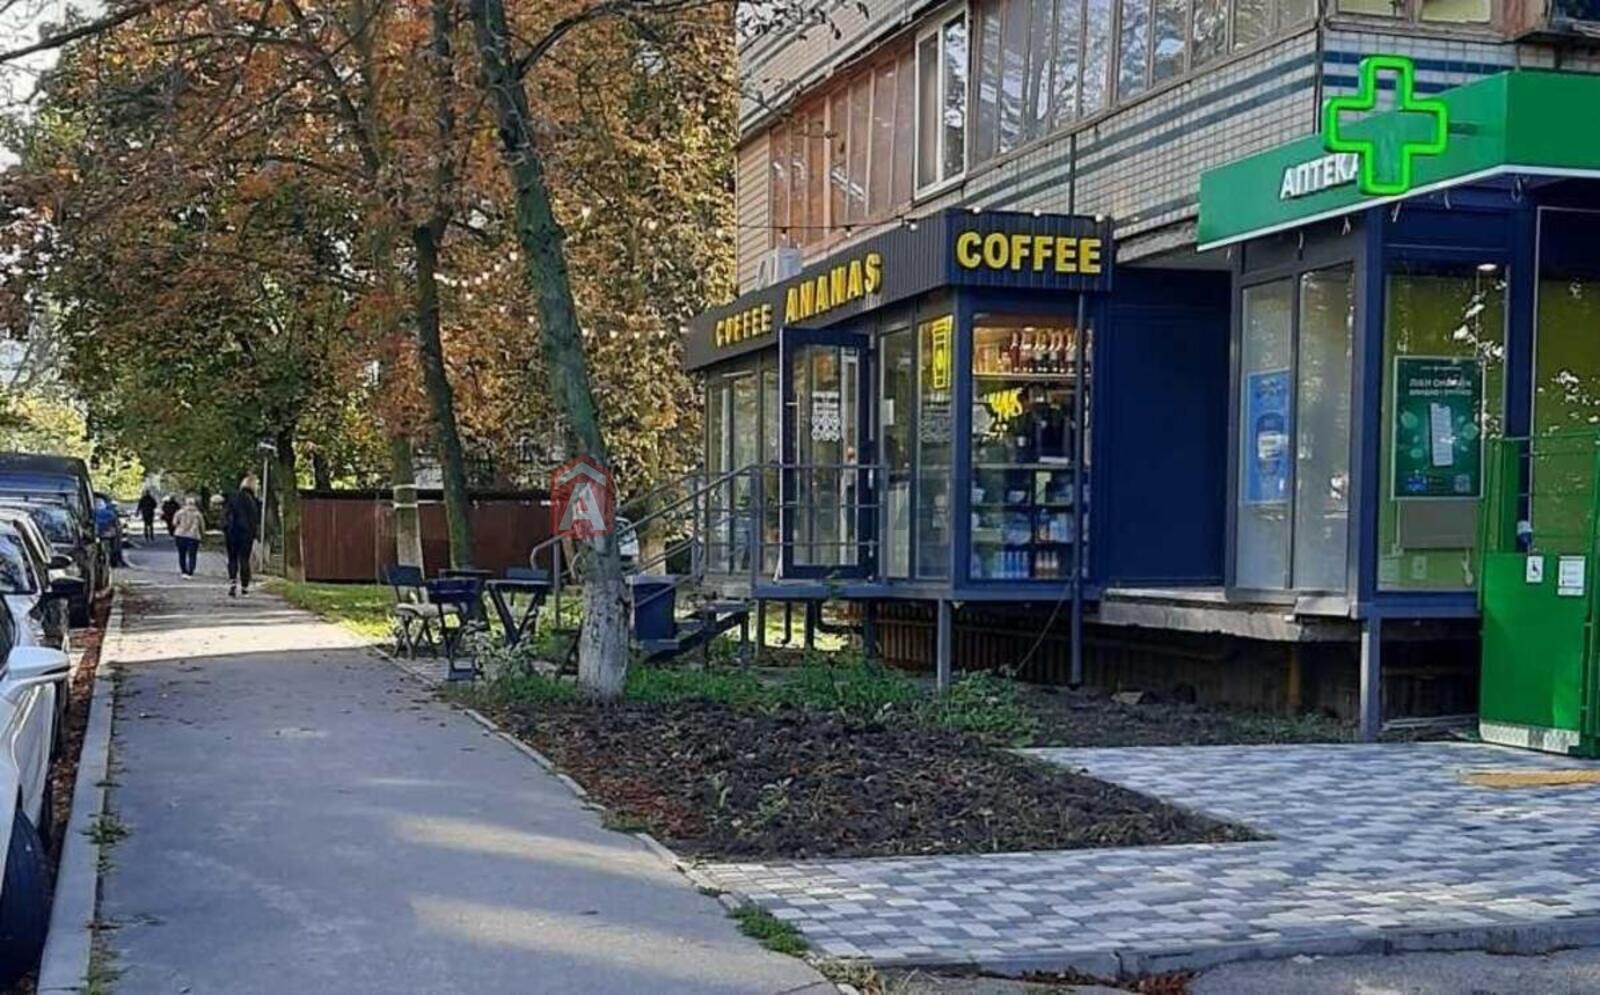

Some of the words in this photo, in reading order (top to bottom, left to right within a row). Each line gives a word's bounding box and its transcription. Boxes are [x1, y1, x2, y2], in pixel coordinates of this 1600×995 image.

[956, 231, 1101, 274] COFFEE
[716, 303, 772, 347] COFFEE
[785, 253, 881, 324] ANANAS
